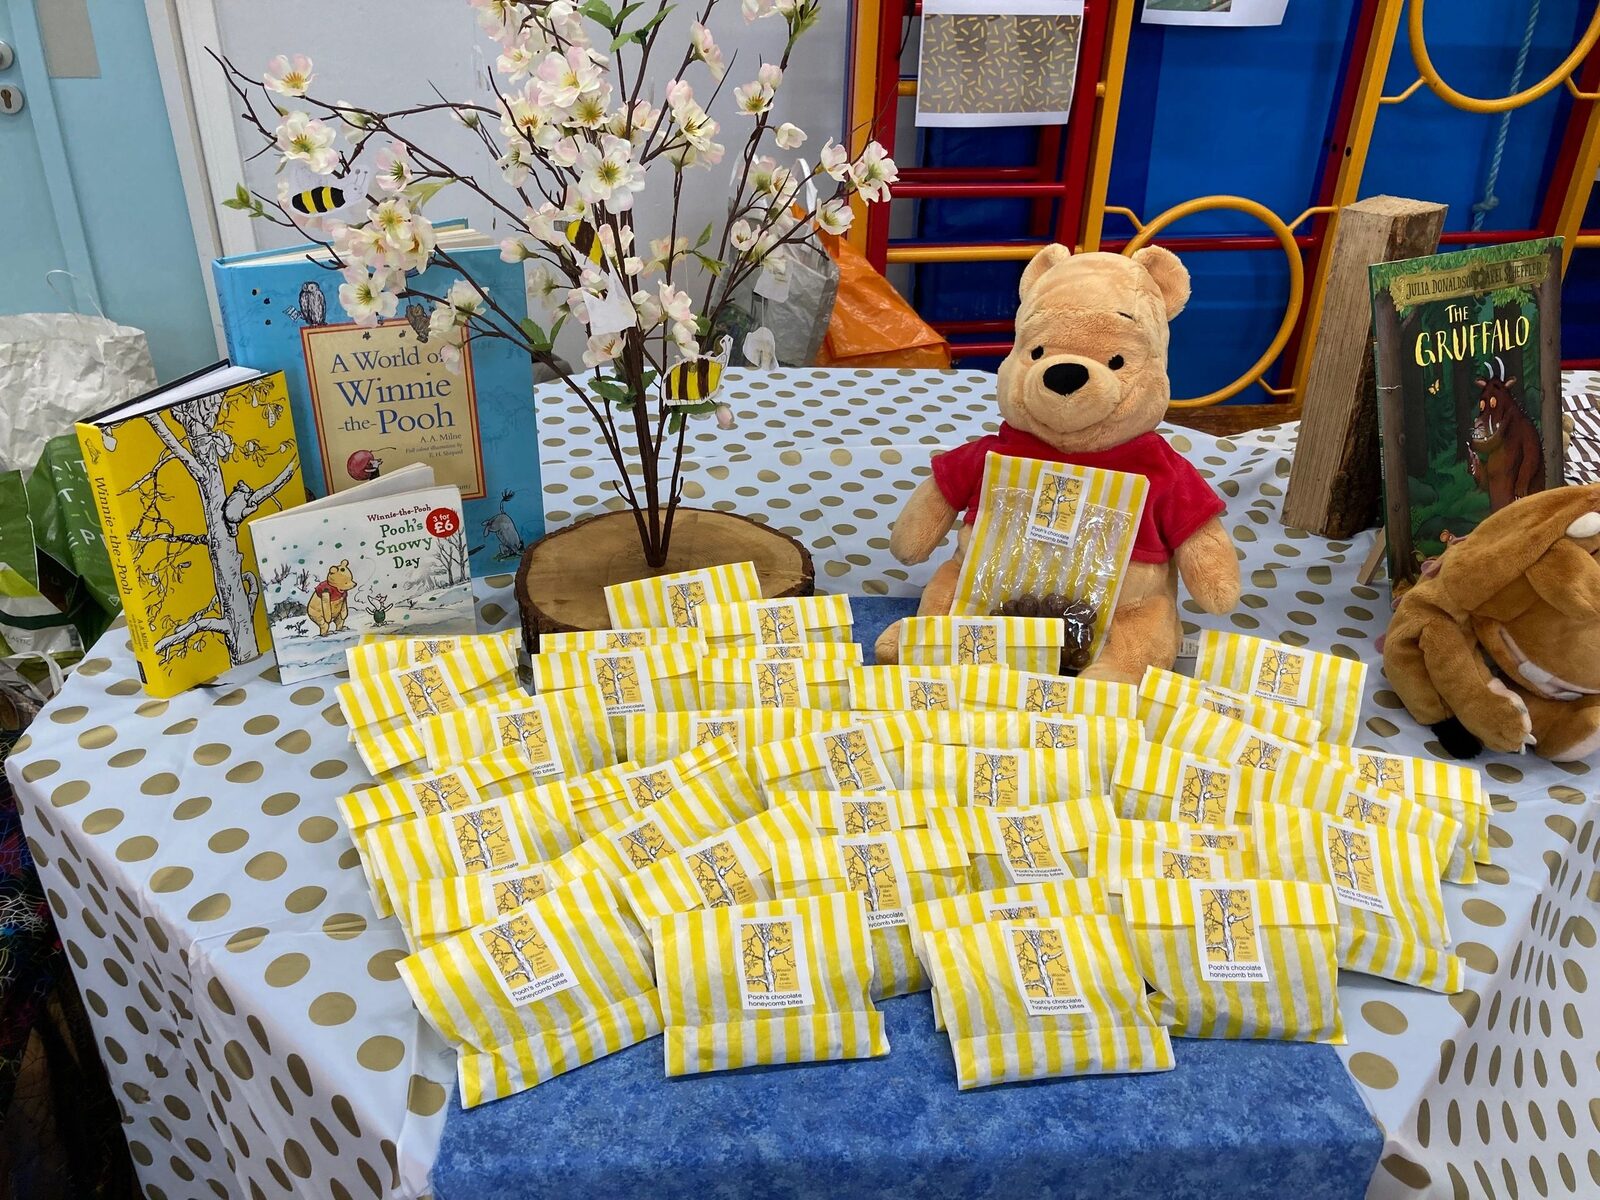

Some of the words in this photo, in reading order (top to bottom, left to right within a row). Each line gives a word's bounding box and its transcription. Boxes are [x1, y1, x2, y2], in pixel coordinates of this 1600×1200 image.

[1406, 281, 1430, 299] JULIA
[1445, 304, 1469, 323] THE
[1415, 316, 1530, 366] GRUFFALO
[330, 354, 350, 374] A
[351, 346, 421, 371] World
[333, 372, 452, 407] Winnie
[440, 433, 461, 441] Milne
[367, 504, 431, 522] Winnie-the-Pooh
[380, 518, 424, 538] Pooh's
[434, 519, 454, 533] £6
[95, 477, 133, 595] Winnie-the-Pooh
[375, 537, 432, 556] Snowy
[393, 555, 421, 569] Day
[875, 912, 904, 920] chocolate
[512, 985, 534, 997] Pooh's
[535, 972, 564, 988] chocolate
[516, 985, 552, 1002] honeycomb
[553, 979, 568, 988] bites
